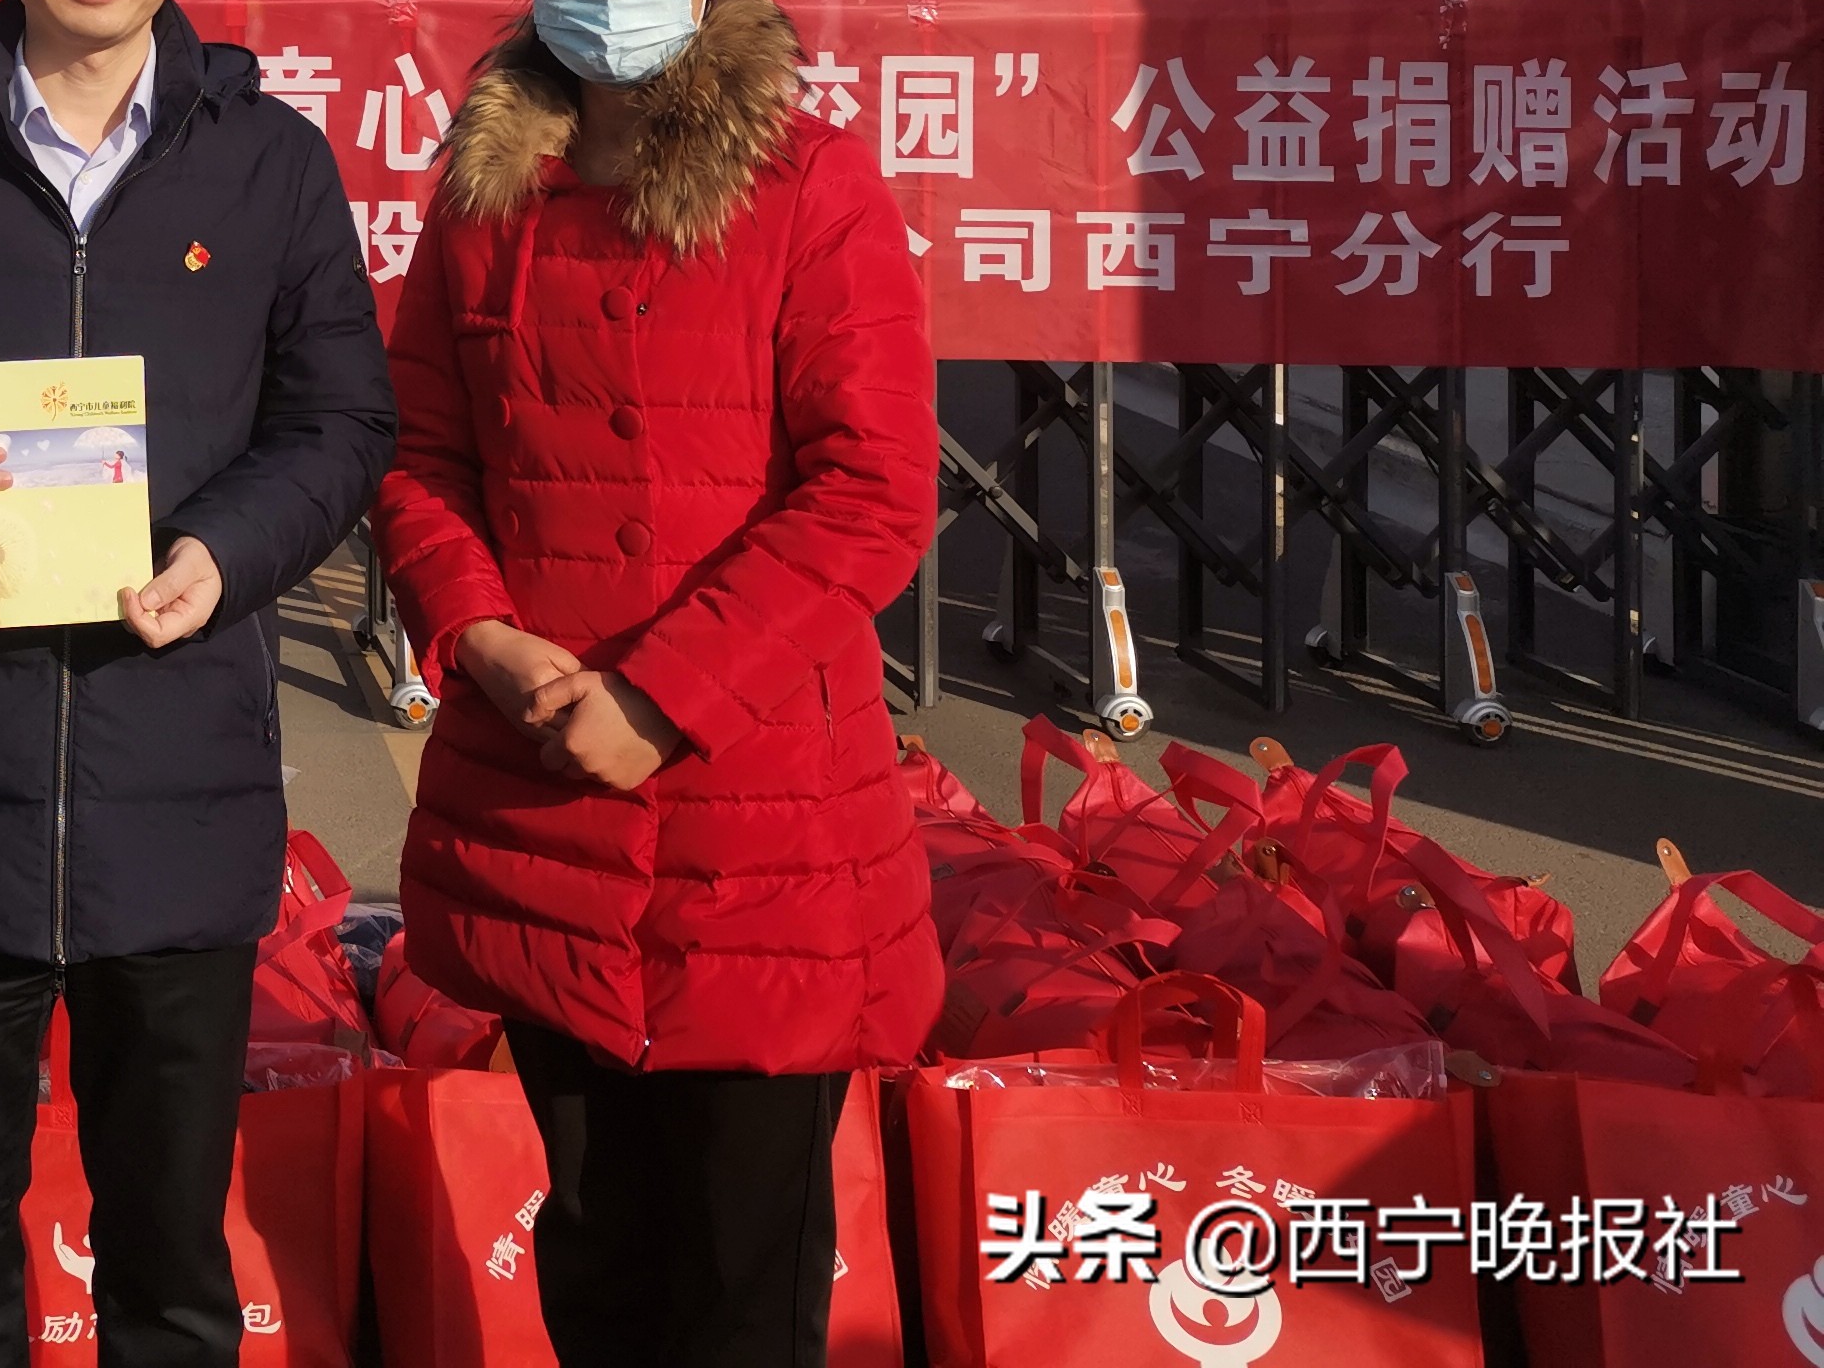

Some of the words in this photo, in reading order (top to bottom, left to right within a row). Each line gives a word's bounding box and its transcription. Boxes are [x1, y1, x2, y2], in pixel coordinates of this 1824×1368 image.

[905, 207, 1571, 298] 司西宁分行
